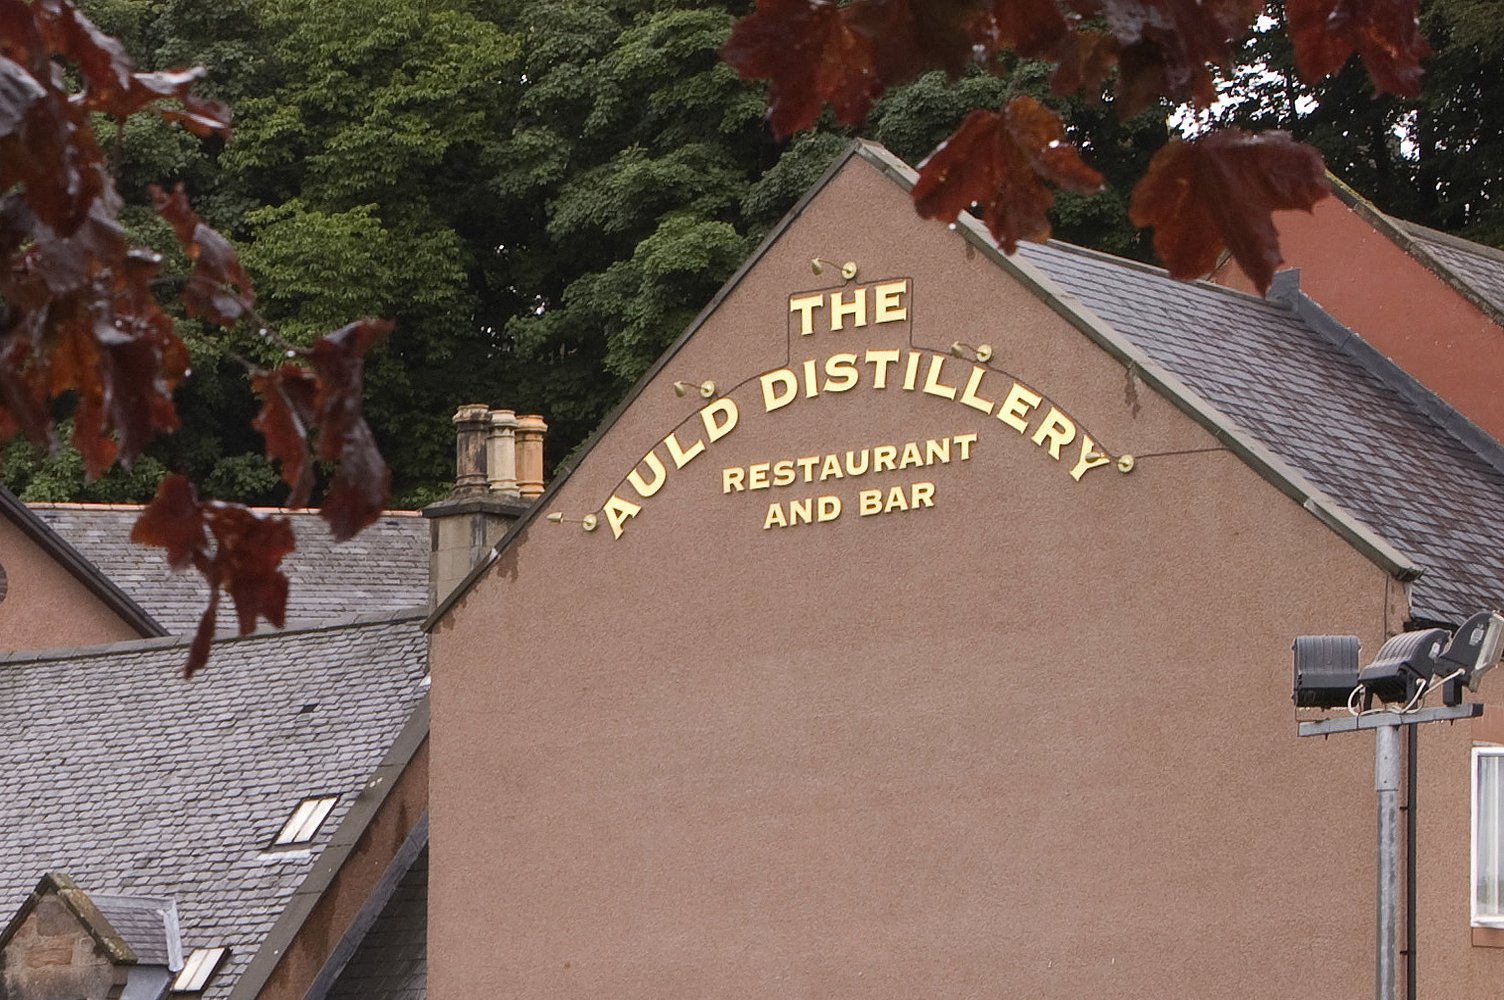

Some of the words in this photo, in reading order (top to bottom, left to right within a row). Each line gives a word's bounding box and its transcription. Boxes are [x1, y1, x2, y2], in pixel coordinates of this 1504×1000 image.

[790, 280, 907, 336] THE
[602, 397, 740, 539] AULD
[759, 348, 1110, 482] DISTILLERY
[722, 432, 978, 493] RESTAURANT
[763, 495, 842, 530] AND
[858, 482, 936, 516] BAR
